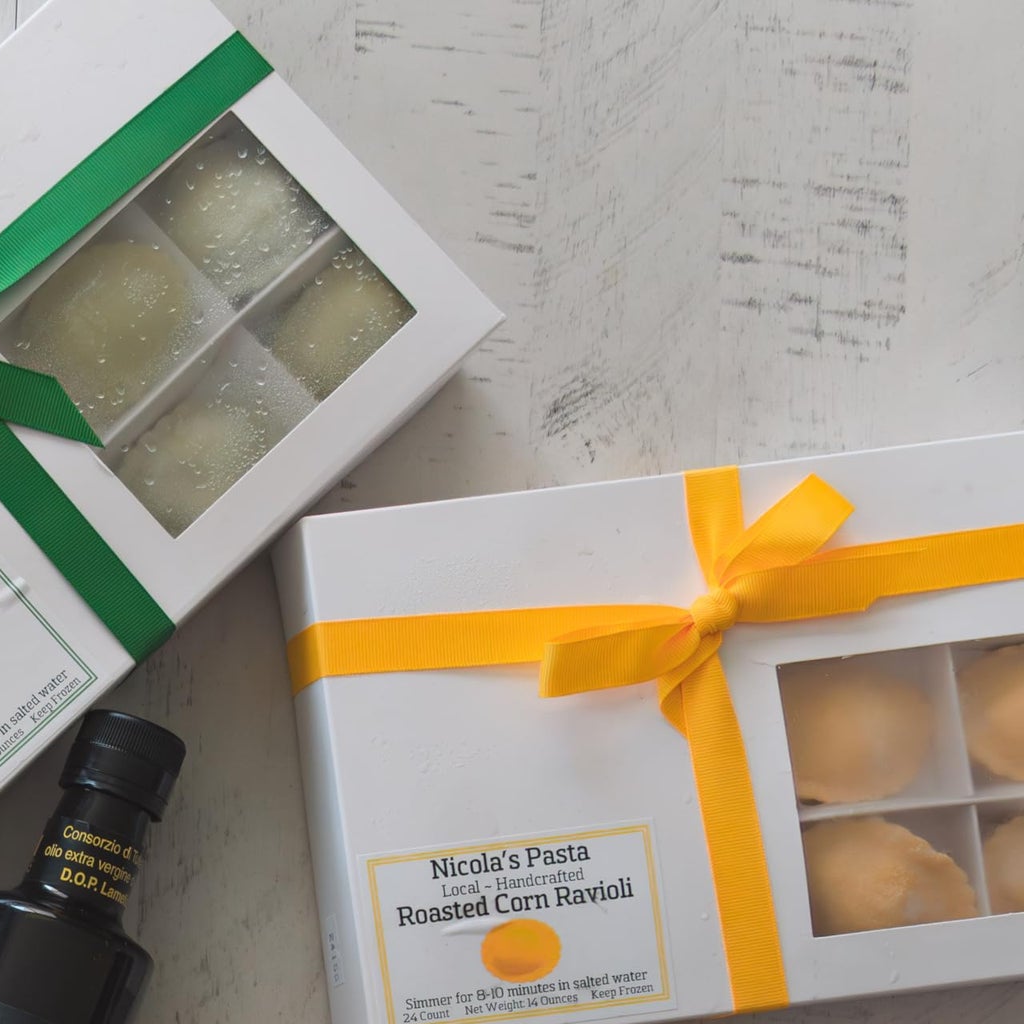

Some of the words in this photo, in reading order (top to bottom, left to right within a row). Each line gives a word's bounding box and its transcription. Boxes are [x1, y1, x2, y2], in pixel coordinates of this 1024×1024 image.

[10, 694, 41, 726] salted
[38, 670, 68, 697] water
[29, 702, 54, 724] Keep
[50, 677, 81, 705] Frozen
[44, 844, 63, 858] olio
[64, 850, 95, 868] extra
[63, 825, 121, 854] Consorzio
[60, 867, 98, 891] D.O.P.
[430, 850, 520, 879] Nicola's
[525, 845, 591, 868] Pasta
[441, 880, 480, 898] Local
[495, 867, 584, 891] Handcrafted
[396, 895, 490, 927] Roasted
[495, 893, 550, 914] Corn
[554, 877, 634, 907] Ravioli
[403, 1012, 418, 1023] 24
[419, 1009, 450, 1021] Count
[465, 1005, 483, 1015] Net
[527, 997, 538, 1008] 14
[540, 994, 578, 1006] Ounces
[590, 989, 617, 1000] Keep
[618, 984, 654, 996] Frozen
[405, 996, 453, 1010] Simmer
[455, 992, 474, 1004] for
[476, 987, 504, 1001] 8-10
[507, 983, 556, 997] minutes
[558, 979, 571, 991] in
[573, 973, 610, 989] salted
[611, 971, 648, 984] water
